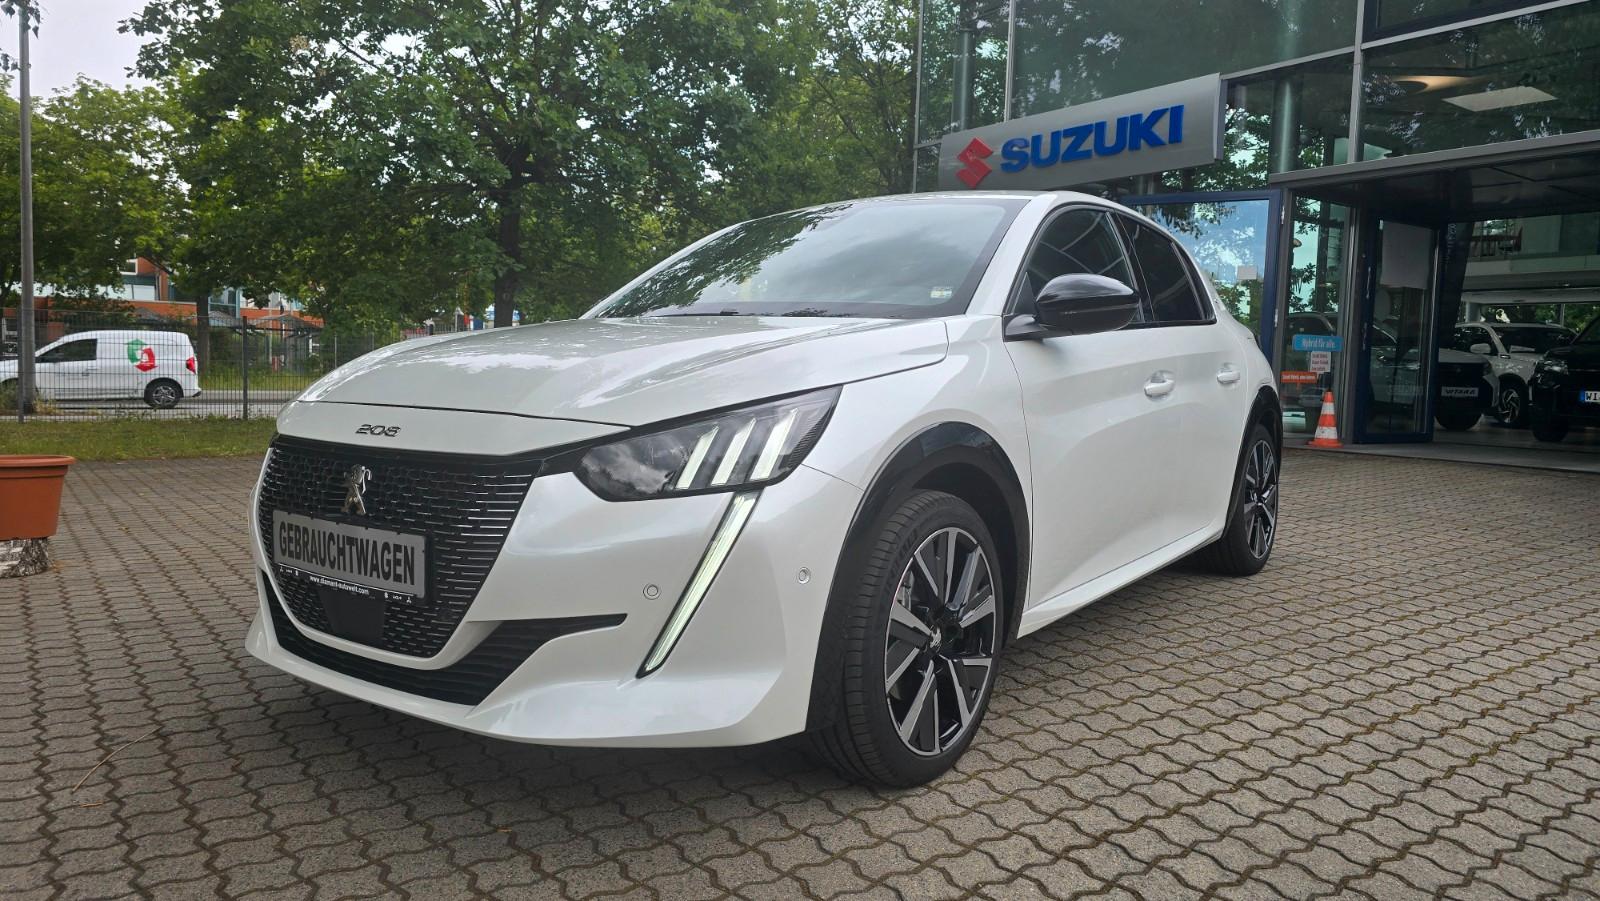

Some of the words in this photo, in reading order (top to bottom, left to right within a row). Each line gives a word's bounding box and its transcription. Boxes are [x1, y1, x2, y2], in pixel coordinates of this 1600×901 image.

[1000, 104, 1184, 173] SUZUKI
[355, 423, 401, 437] 208
[279, 521, 415, 585] GEBRAUCHTWAGEN
